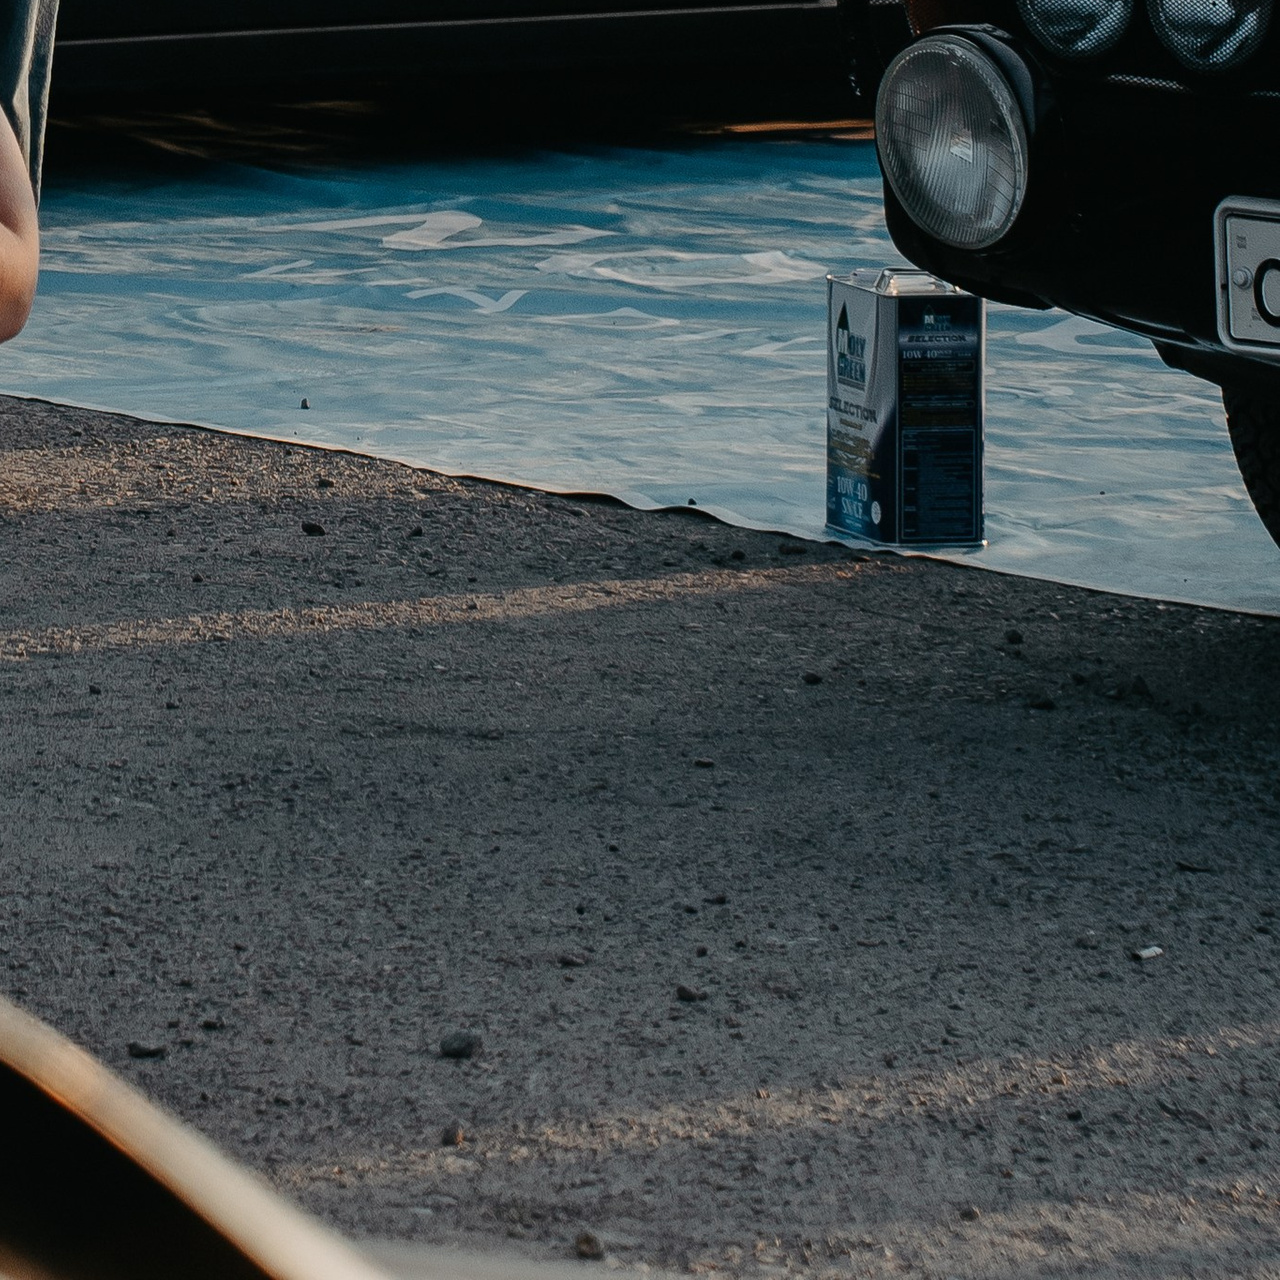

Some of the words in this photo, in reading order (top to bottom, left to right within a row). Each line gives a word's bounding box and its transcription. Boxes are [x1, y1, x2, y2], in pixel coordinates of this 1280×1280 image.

[837, 327, 867, 359] MOLY
[907, 334, 967, 343] SELECTION
[837, 354, 866, 383] GREEN
[828, 396, 878, 424] SELECTION
